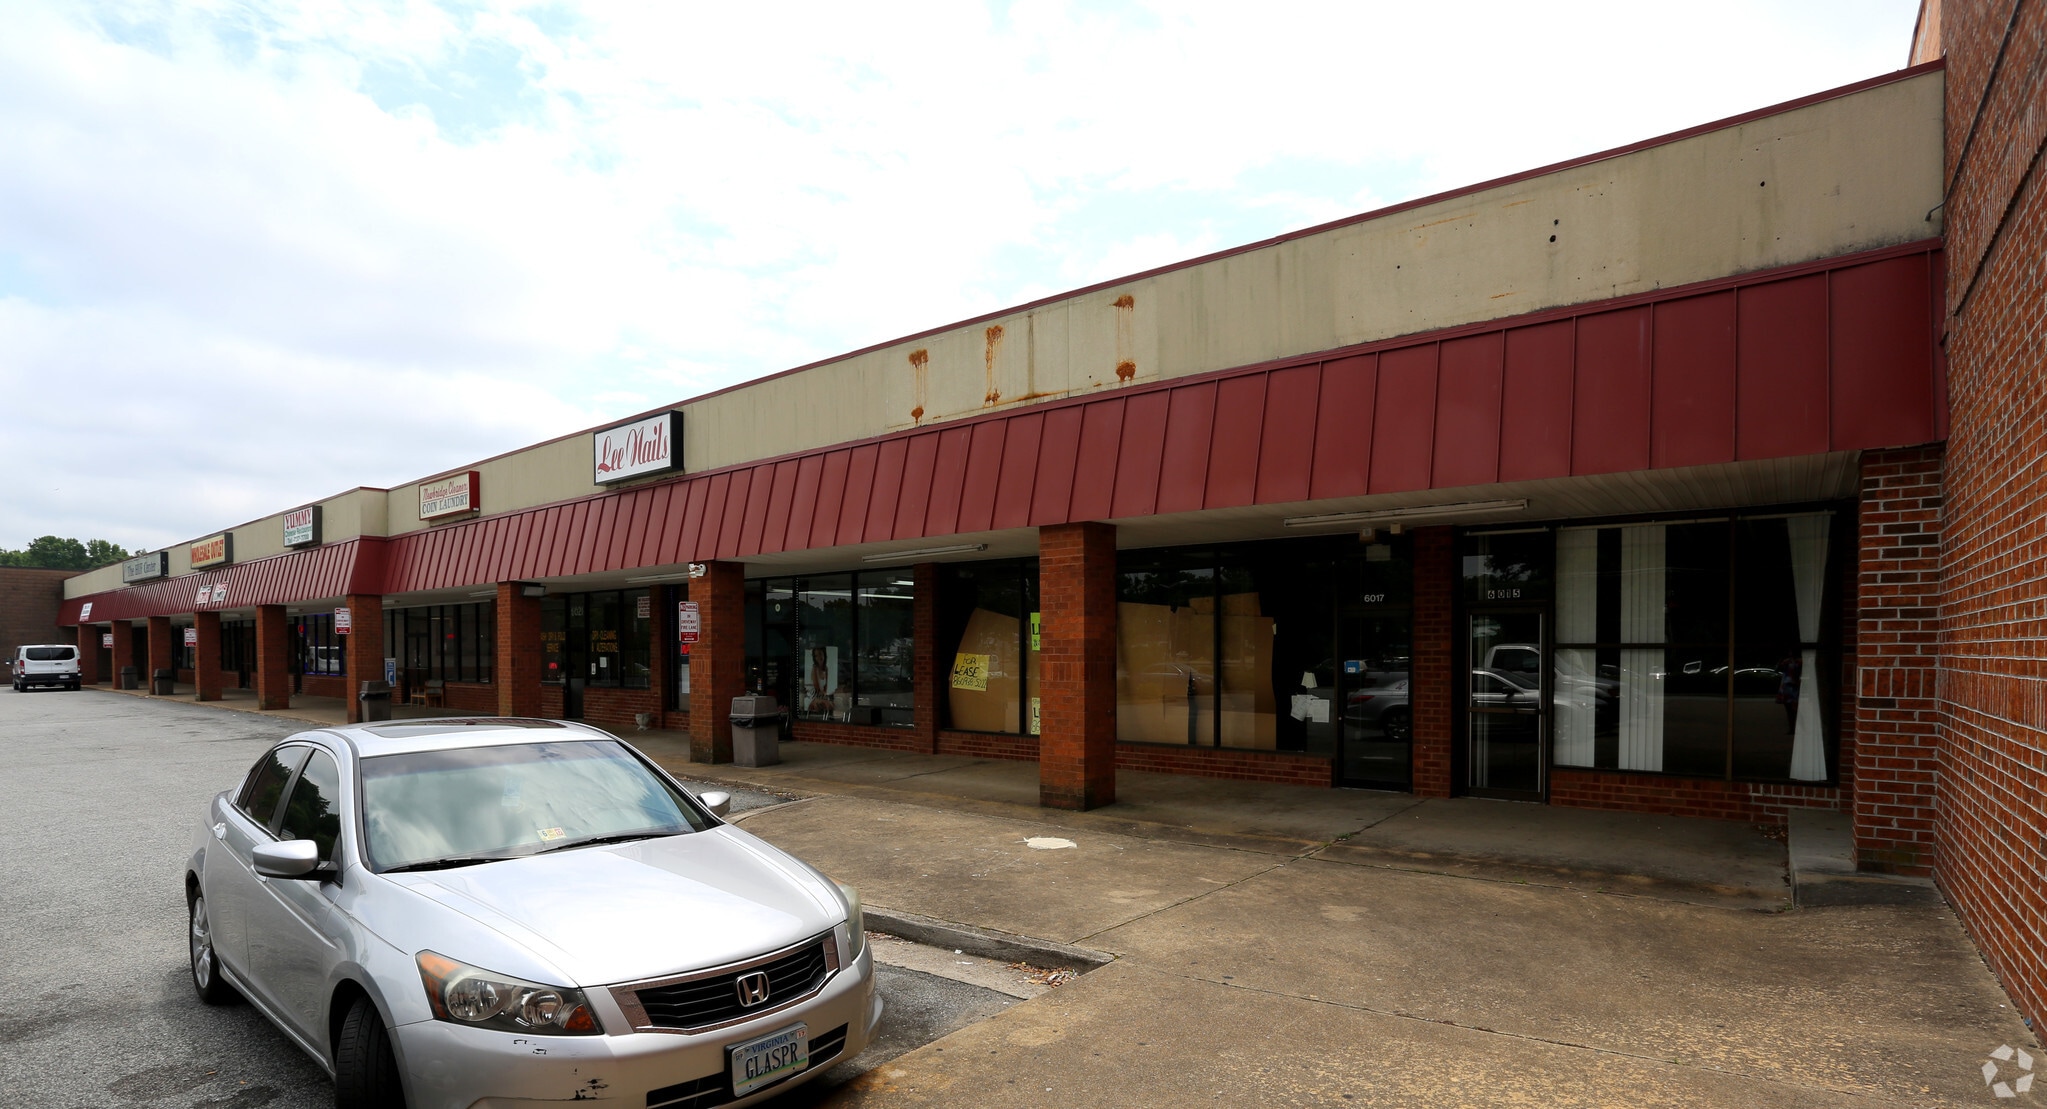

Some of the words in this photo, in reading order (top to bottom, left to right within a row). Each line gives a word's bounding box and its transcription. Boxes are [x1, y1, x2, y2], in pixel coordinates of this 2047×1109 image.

[597, 435, 624, 474] Lee
[626, 421, 669, 467] Nails
[422, 502, 438, 514] COIN
[439, 494, 468, 510] LAUNDRY
[285, 509, 311, 530] YUMMY
[191, 543, 210, 564] WHOLESALE
[210, 538, 224, 560] OUTLET
[143, 561, 157, 574] Center
[1364, 594, 1385, 602] 6017
[1487, 589, 1521, 599] 6015
[963, 655, 977, 665] FOR
[954, 663, 980, 678] LEASE
[752, 1035, 789, 1053] VIRGINIA
[745, 1042, 798, 1079] GLASPR
